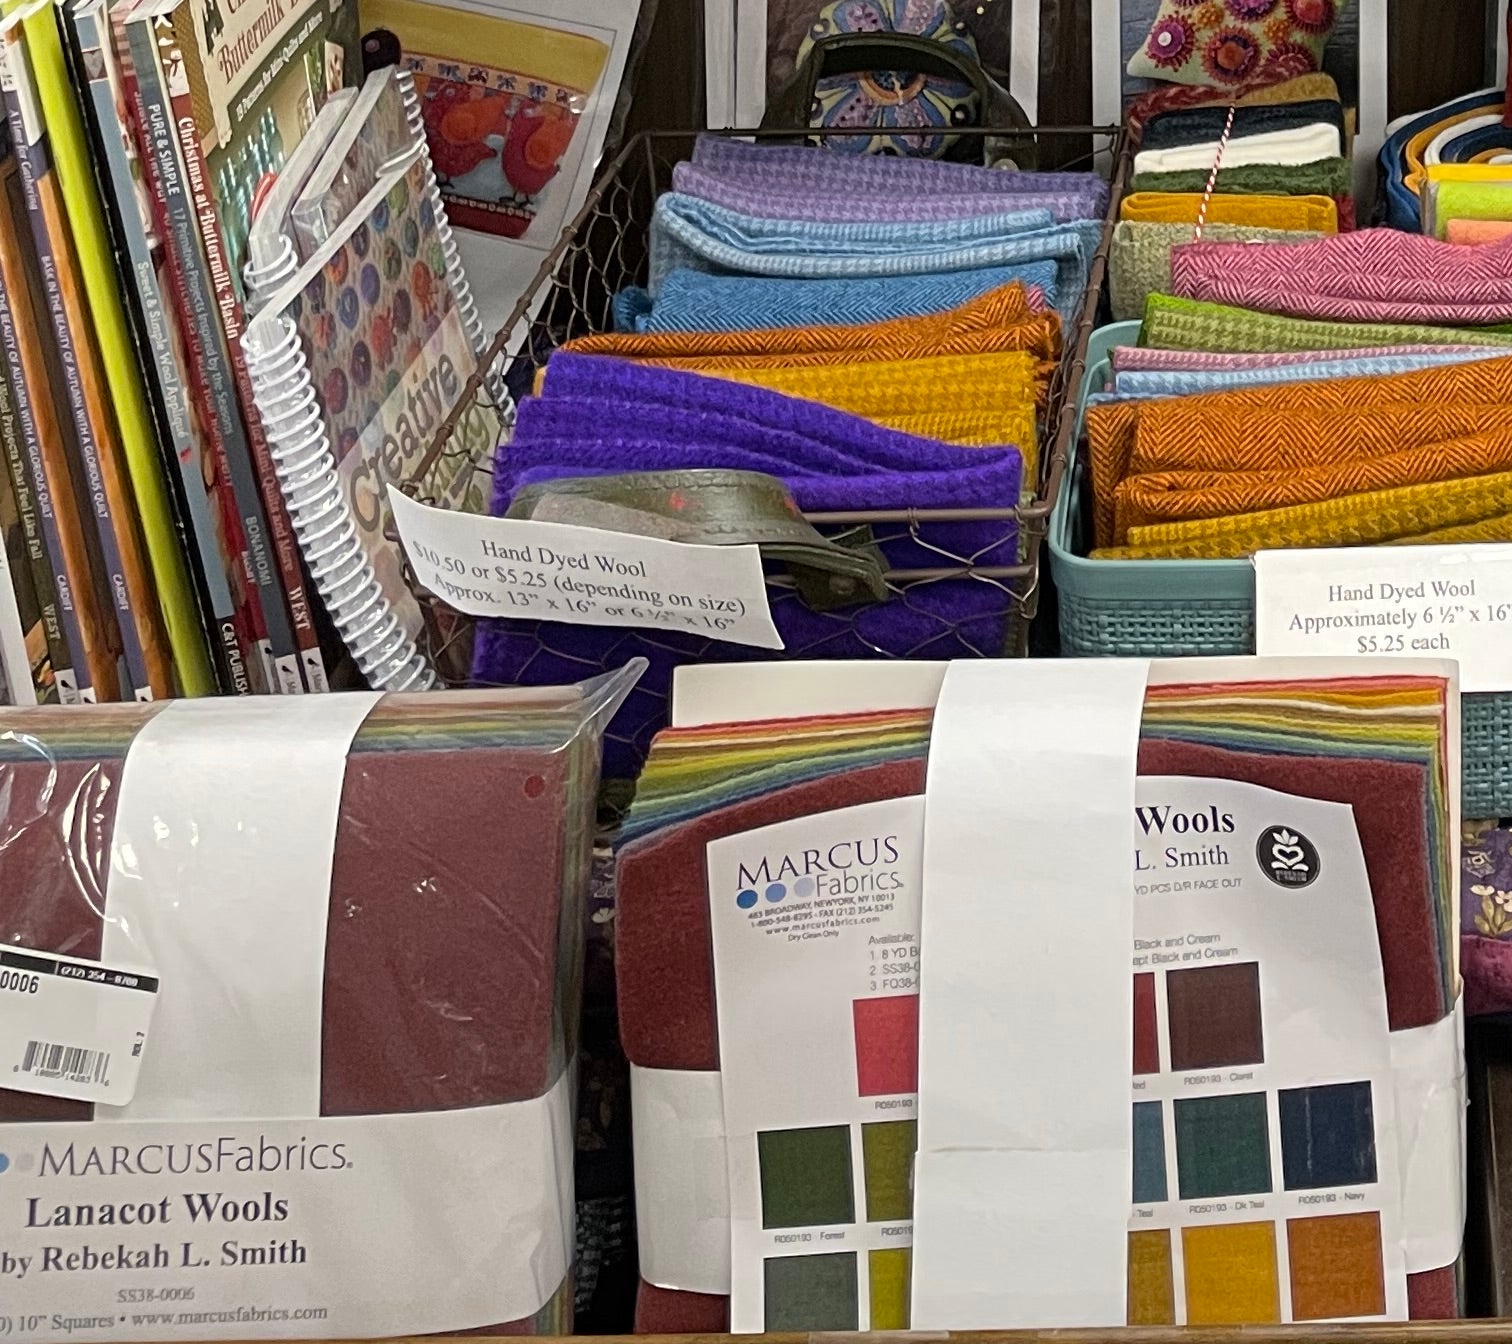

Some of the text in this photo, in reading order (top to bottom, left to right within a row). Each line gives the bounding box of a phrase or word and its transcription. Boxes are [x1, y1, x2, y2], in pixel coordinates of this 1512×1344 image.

[13, 120, 23, 143] Time
[16, 144, 27, 159] for
[149, 103, 178, 194] PURE & SIMPLE
[178, 117, 238, 340] Christmas at Buttermilk Basin
[42, 255, 52, 280] BASK
[136, 261, 155, 297] Sweet
[48, 281, 55, 292] IN
[51, 294, 60, 312] THE
[147, 299, 156, 307] &
[0, 312, 16, 350] BEAUTY
[55, 314, 68, 349] BEAUTY
[147, 309, 167, 350] Simple
[174, 207, 233, 433] 17 Primitive Projects Inspired by the Seasons
[9, 351, 17, 363] OF
[63, 351, 71, 363] OF
[158, 352, 175, 383] Wool
[12, 365, 27, 407] AUTUMN
[66, 364, 81, 407] AUTUMN
[22, 409, 33, 434] WITH
[77, 410, 87, 434] WITH
[350, 353, 458, 533] Creative
[29, 445, 45, 491] GLORIOUS
[84, 445, 100, 491] GLORIOUS
[0, 414, 40, 559] Projects That Feel Like Fall
[39, 492, 50, 517] QUILT
[95, 492, 107, 517] QUILT
[245, 516, 272, 585] BONANOMI
[481, 540, 647, 578] Hand Dyed Wool
[57, 575, 72, 611] CARDIFF
[112, 574, 129, 610] CARDIFF
[412, 540, 746, 617] $10.50 or $5.25 (depending on size)
[1328, 579, 1476, 604] Hand Dyed Wool
[288, 586, 310, 629] WEST
[434, 573, 501, 605] Approx.
[547, 597, 559, 610] x
[605, 605, 625, 617] or
[685, 615, 698, 626] x
[44, 604, 61, 640] WEST
[1288, 605, 1417, 634] Approximately
[1423, 607, 1433, 623] 6
[1469, 610, 1480, 622] x
[221, 622, 236, 647] C&T
[1357, 632, 1450, 654] $5.25 each
[1135, 805, 1235, 836] Wools
[736, 835, 899, 891] MARCUS
[1135, 845, 1229, 871] L. Smith
[857, 895, 870, 903] NY
[1150, 883, 1172, 894] PCS
[1193, 879, 1219, 889] FACE
[1221, 878, 1242, 888] OUT
[765, 915, 880, 935] www.marcusfabrics.com
[818, 909, 834, 918] FAX
[788, 933, 801, 942] Dry
[822, 929, 840, 938] Only
[1134, 934, 1221, 951] Black and Cream
[881, 949, 889, 959] 8
[891, 947, 907, 958] YD
[1151, 953, 1180, 965] Black
[1182, 950, 1201, 960] and
[1204, 947, 1239, 959] Cream
[25, 1191, 289, 1228] Lanacot Wools
[1344, 1192, 1365, 1202] Navy
[0, 1239, 307, 1278] by Rebekah L. Smith
[51, 1314, 115, 1333] Squares
[131, 1305, 328, 1327] www.marcusfabrics.com
